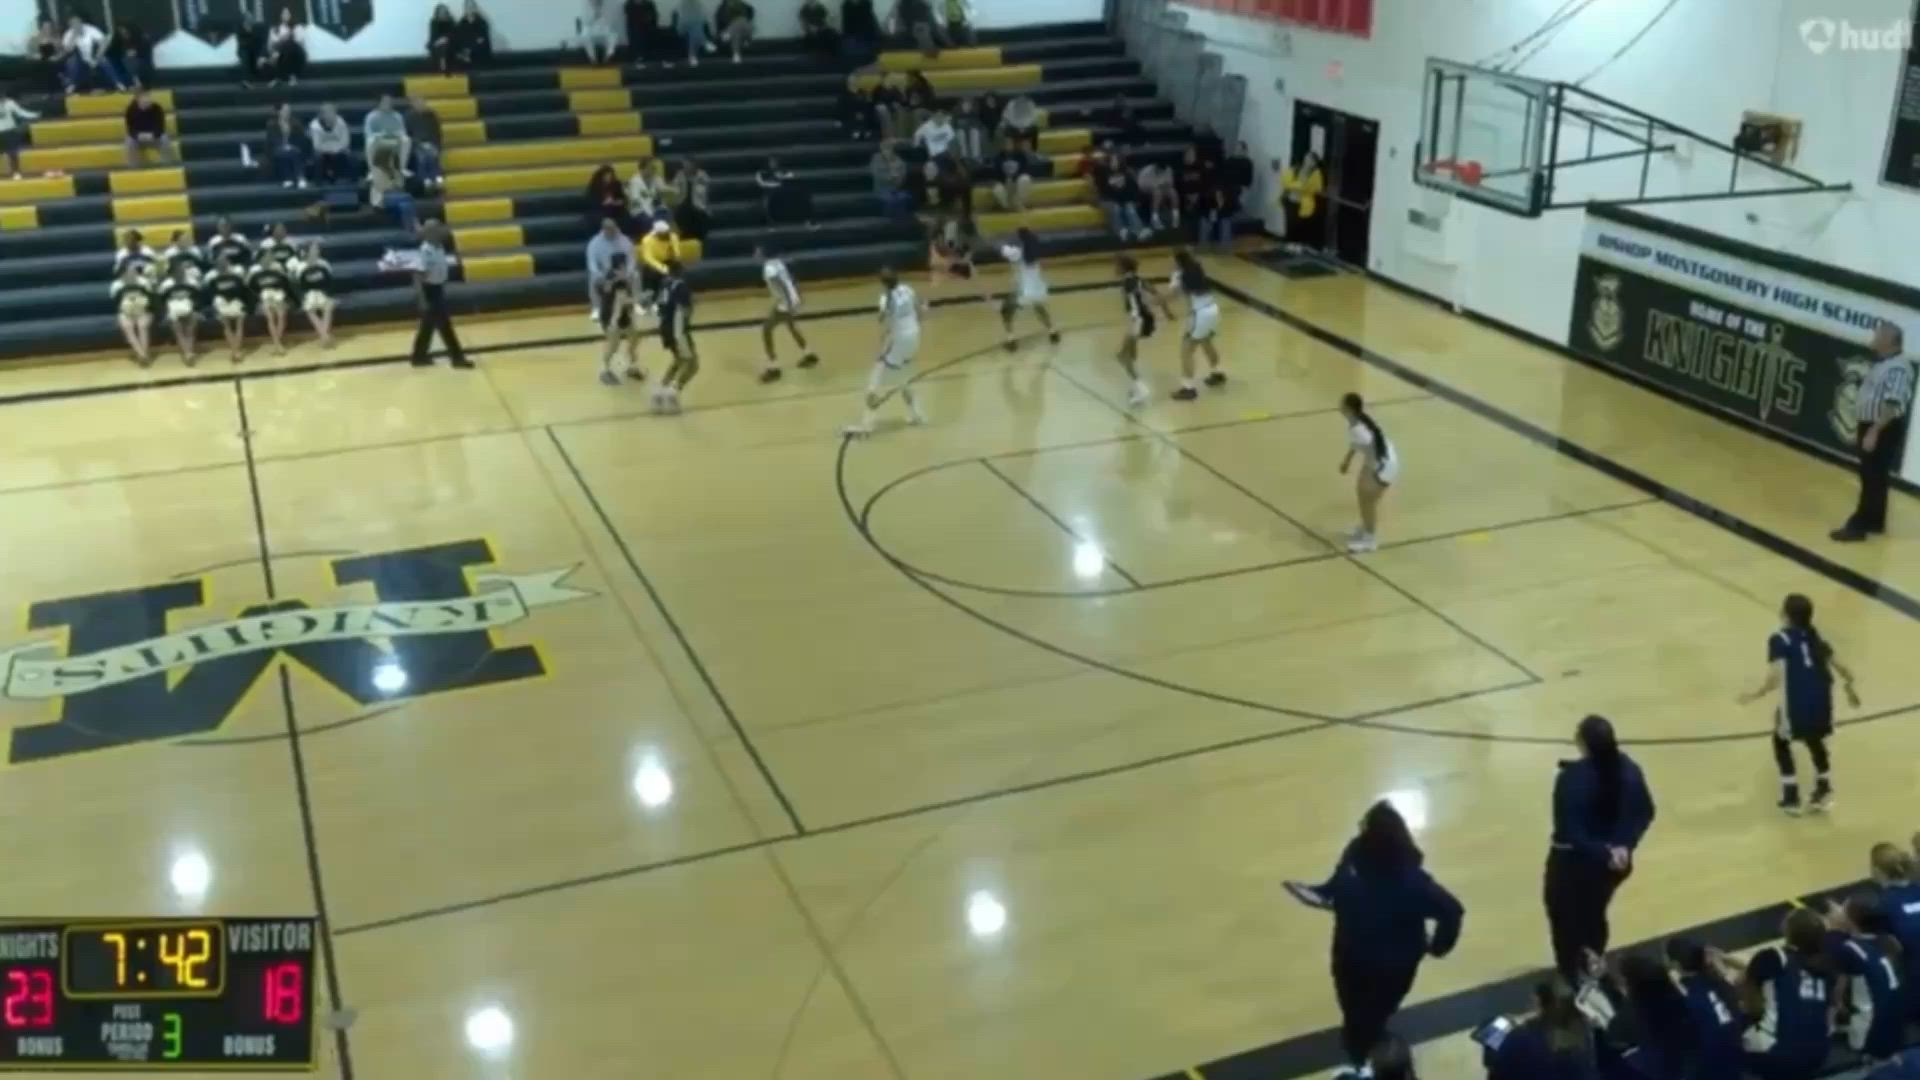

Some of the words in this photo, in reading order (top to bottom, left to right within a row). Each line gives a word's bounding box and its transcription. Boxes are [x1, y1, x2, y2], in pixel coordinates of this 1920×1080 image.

[1655, 250, 1768, 299] MONTGOMERY
[1773, 286, 1819, 313] HIGH
[1643, 307, 1808, 421] KNIGHTS
[52, 600, 490, 688] KNIGHTS
